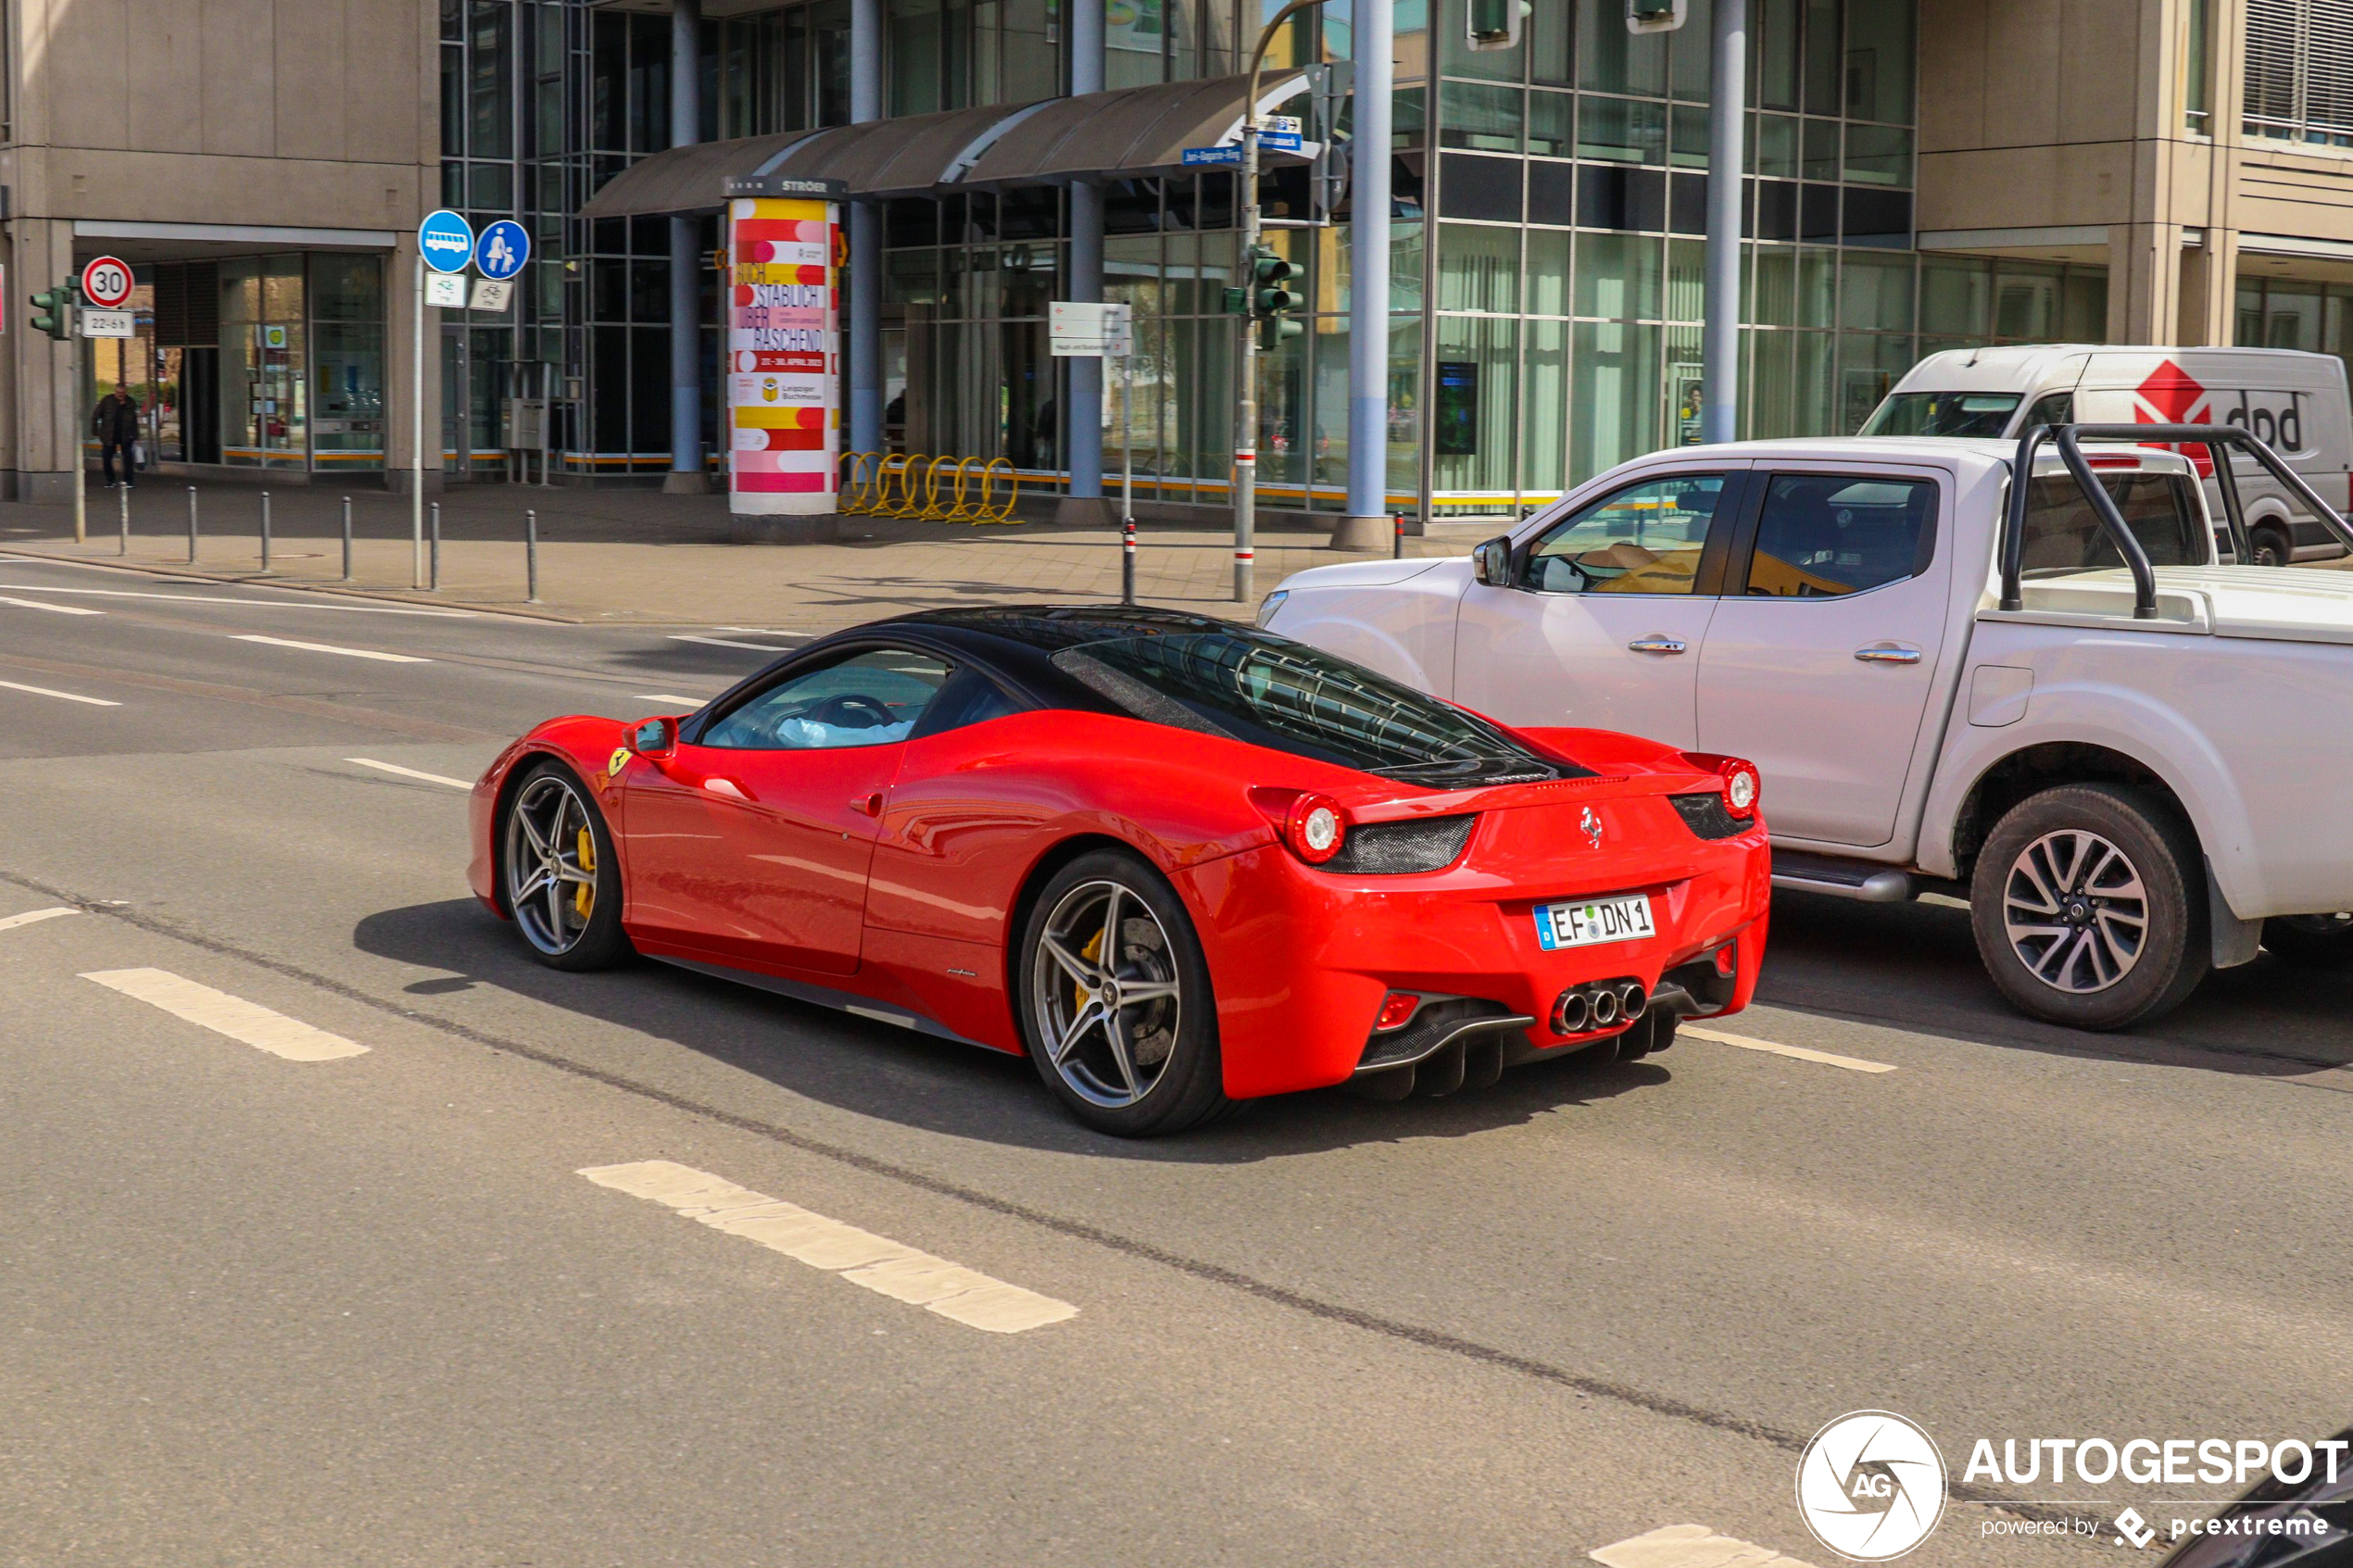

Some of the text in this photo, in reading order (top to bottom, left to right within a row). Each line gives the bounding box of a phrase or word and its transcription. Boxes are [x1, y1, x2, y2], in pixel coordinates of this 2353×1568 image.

[781, 181, 827, 193] STRÖER
[95, 271, 122, 293] 30
[754, 329, 823, 351] RASCHEND
[2227, 390, 2302, 466] dpd
[1553, 908, 1583, 941] EF
